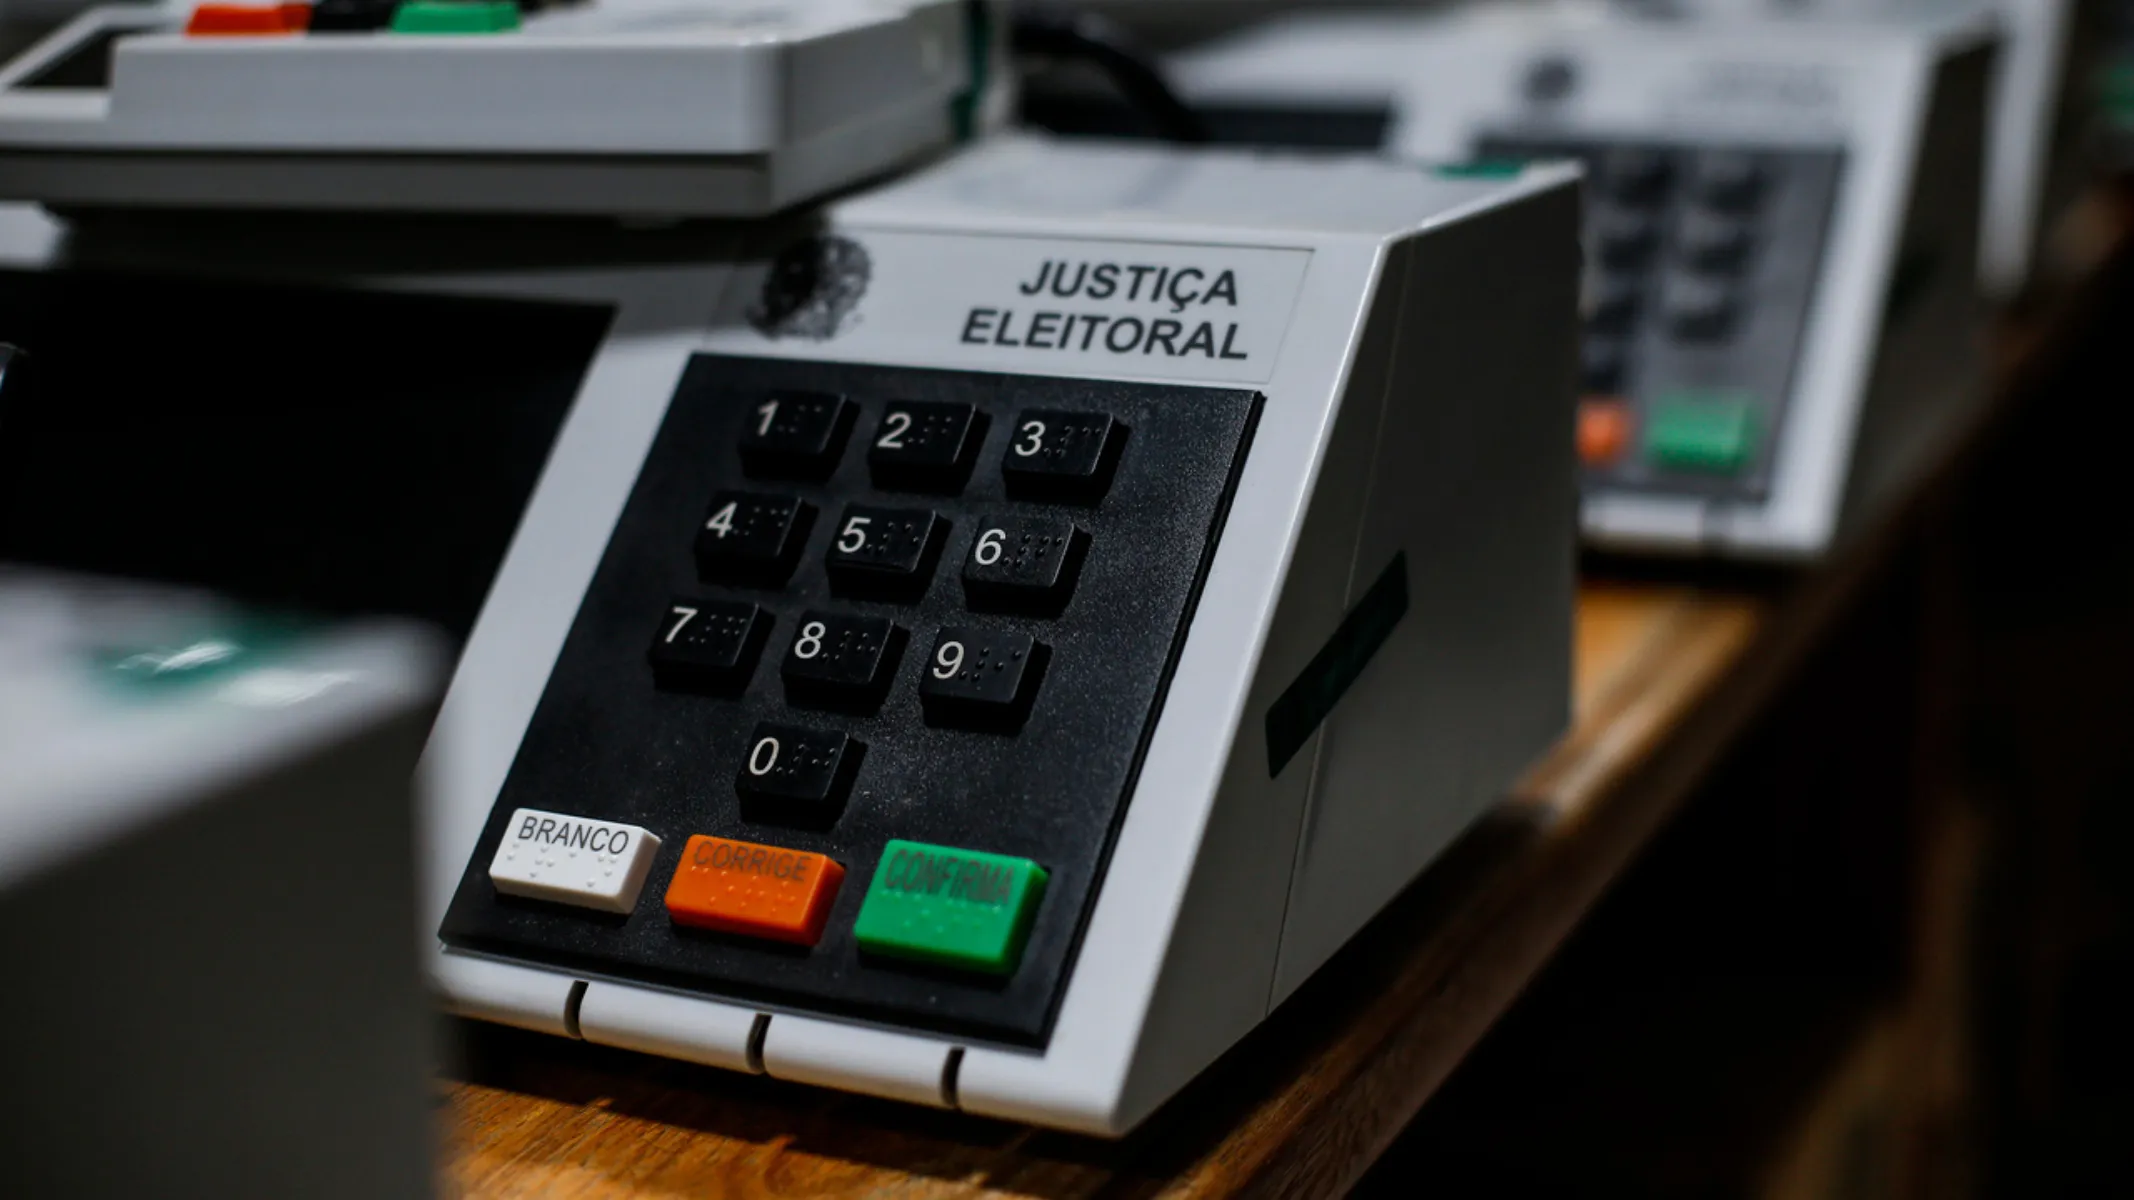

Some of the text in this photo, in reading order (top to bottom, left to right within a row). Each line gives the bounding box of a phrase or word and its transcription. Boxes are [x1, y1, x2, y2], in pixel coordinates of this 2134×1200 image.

[1019, 260, 1238, 312] JUSTIÇA
[959, 307, 1249, 361] ELEITORAL
[757, 401, 780, 436] 1
[877, 412, 912, 449] 2
[1014, 421, 1044, 456] 3
[706, 501, 735, 539] 4
[837, 517, 871, 554] 5
[974, 528, 1006, 566] 6
[664, 606, 698, 644] 7
[793, 620, 827, 659] 8
[932, 641, 965, 680] 9
[748, 737, 780, 776] 0
[517, 815, 629, 856] BRANCO
[692, 841, 811, 883] CORRIGE
[884, 848, 1014, 903] CONFIRMA
